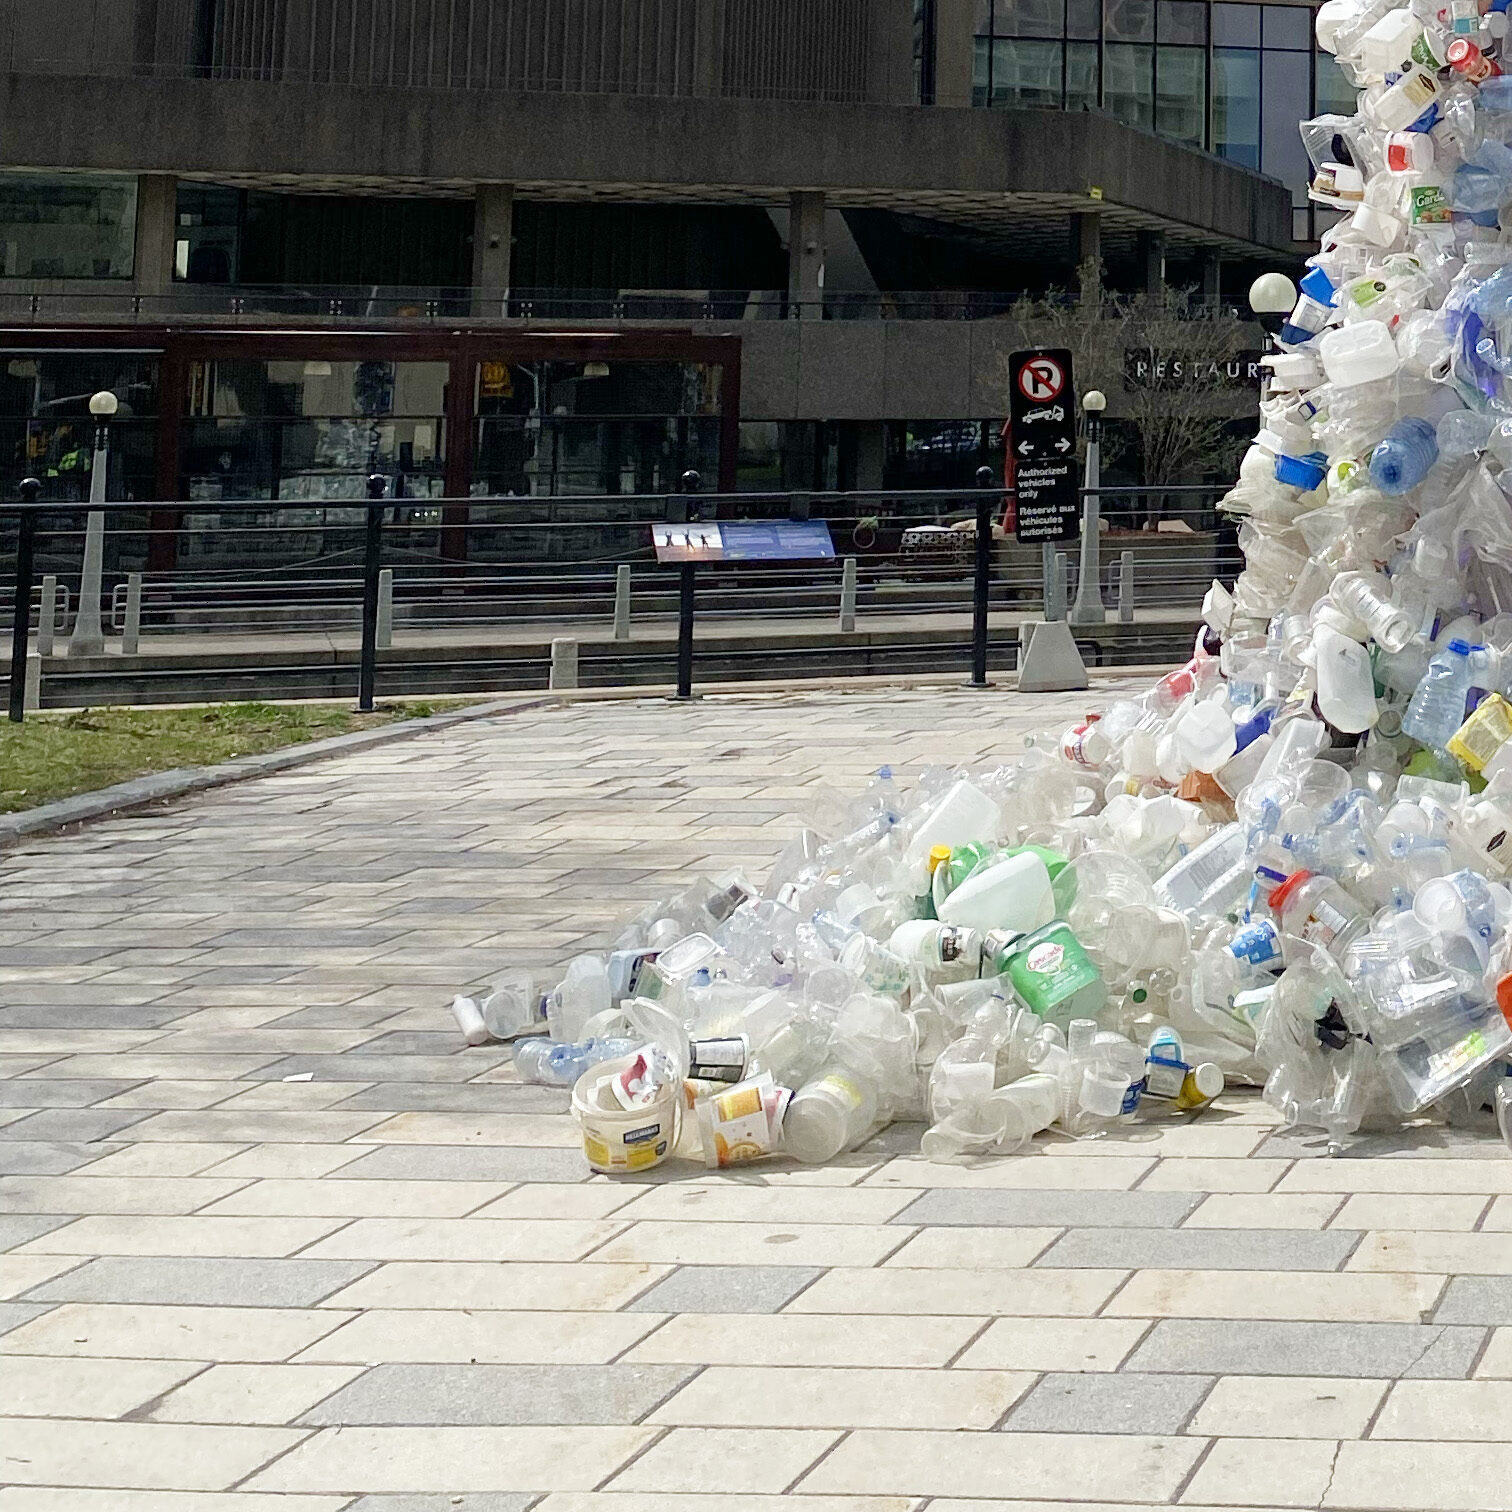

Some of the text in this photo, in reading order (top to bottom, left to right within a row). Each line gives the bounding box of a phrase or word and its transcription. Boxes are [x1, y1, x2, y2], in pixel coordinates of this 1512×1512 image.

[1017, 466, 1068, 478] Authorized
[1018, 478, 1056, 488] vehicles
[1018, 488, 1039, 499] only
[1019, 505, 1076, 516] Réservé aux
[1019, 515, 1064, 526] véhicules
[1020, 525, 1064, 537] autorisés
